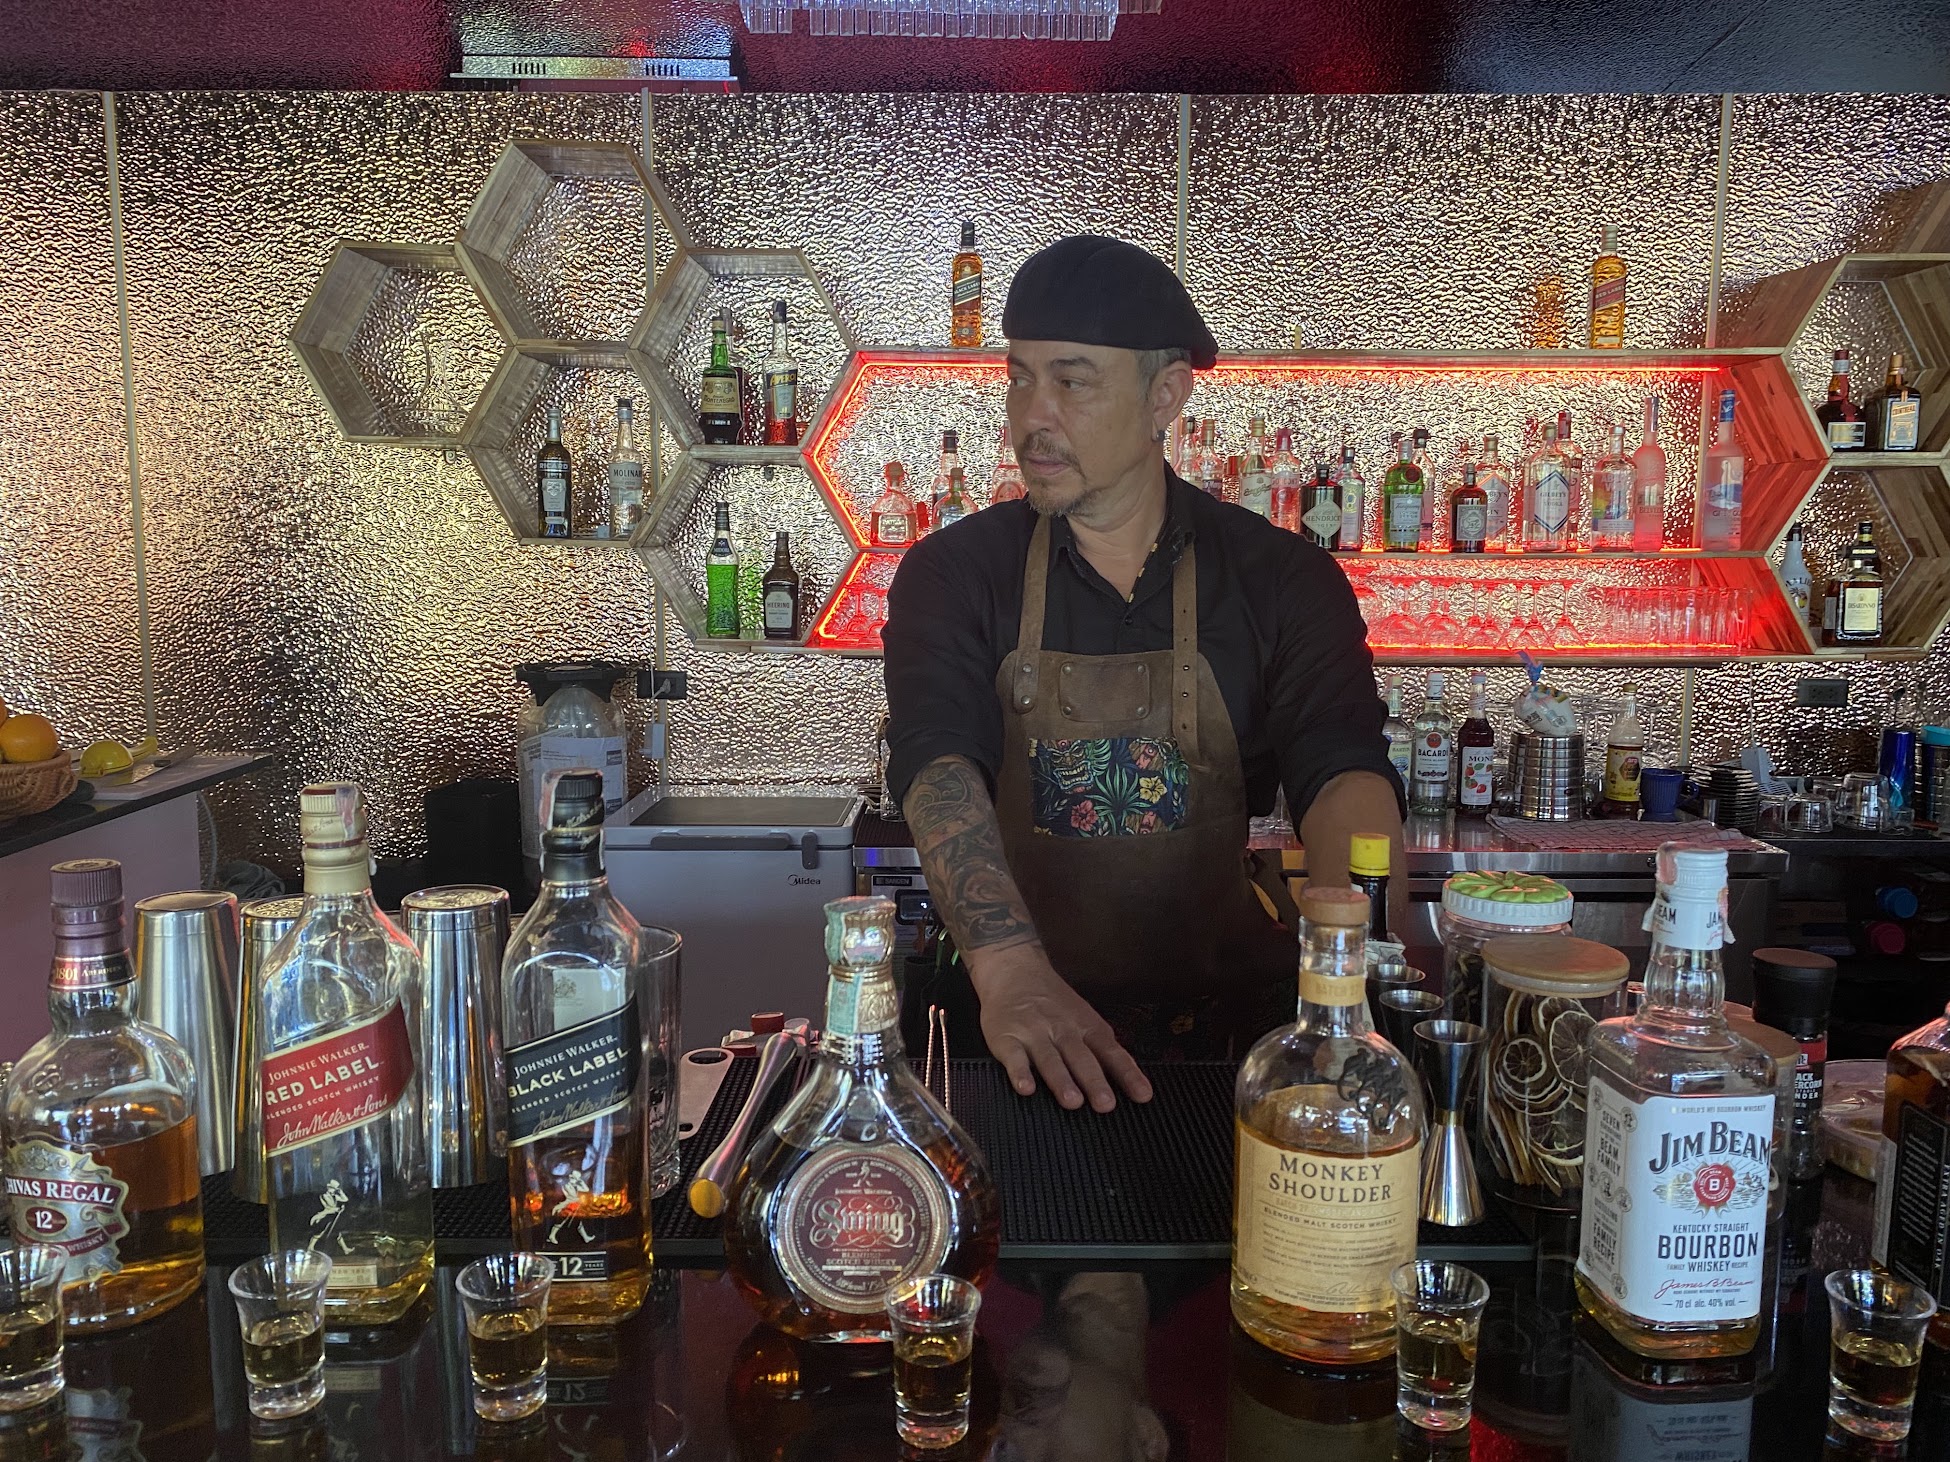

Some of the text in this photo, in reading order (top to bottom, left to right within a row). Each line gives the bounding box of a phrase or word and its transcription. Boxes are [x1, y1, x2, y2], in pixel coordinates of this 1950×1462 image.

[1607, 285, 1624, 295] LABEL
[55, 967, 79, 982] 1801
[268, 1042, 366, 1086] JOHNNIE WALKER
[514, 1033, 615, 1080] JOHNNIE WALKER
[265, 1055, 379, 1106] RED LABEL
[508, 1047, 628, 1099] BLACK LABEL
[306, 1090, 341, 1107] SCOTCH
[344, 1075, 380, 1093] WHISKY
[554, 1083, 589, 1100] SCOTCH
[361, 1093, 388, 1115] Sons
[1600, 1137, 1619, 1161] BEAM
[1649, 1132, 1705, 1174] JIM
[1709, 1121, 1772, 1167] BEAM
[1279, 1153, 1384, 1182] MONKEY
[1598, 1149, 1620, 1176] FAMILY
[46, 1181, 115, 1204] REGAL
[1268, 1172, 1391, 1204] SHOULDER
[1709, 1179, 1720, 1191] B
[35, 1210, 53, 1230] 12
[816, 1199, 908, 1244] Swing
[1263, 1206, 1301, 1224] BLENDED
[1303, 1218, 1326, 1228] MALT
[1368, 1217, 1397, 1229] WHISKY
[1672, 1222, 1750, 1234] KENTUCKY STRAIGHT
[67, 1230, 104, 1253] WHISKY
[1593, 1222, 1617, 1252] FAMILY
[1657, 1232, 1759, 1260] BOURBON
[1593, 1235, 1615, 1266] RECIPE
[559, 1256, 583, 1276] 12
[1688, 1260, 1731, 1272] WHISKEY
[1731, 1261, 1749, 1269] RECIPE
[1675, 1298, 1736, 1309] 70 cl alc. 40% vol.
